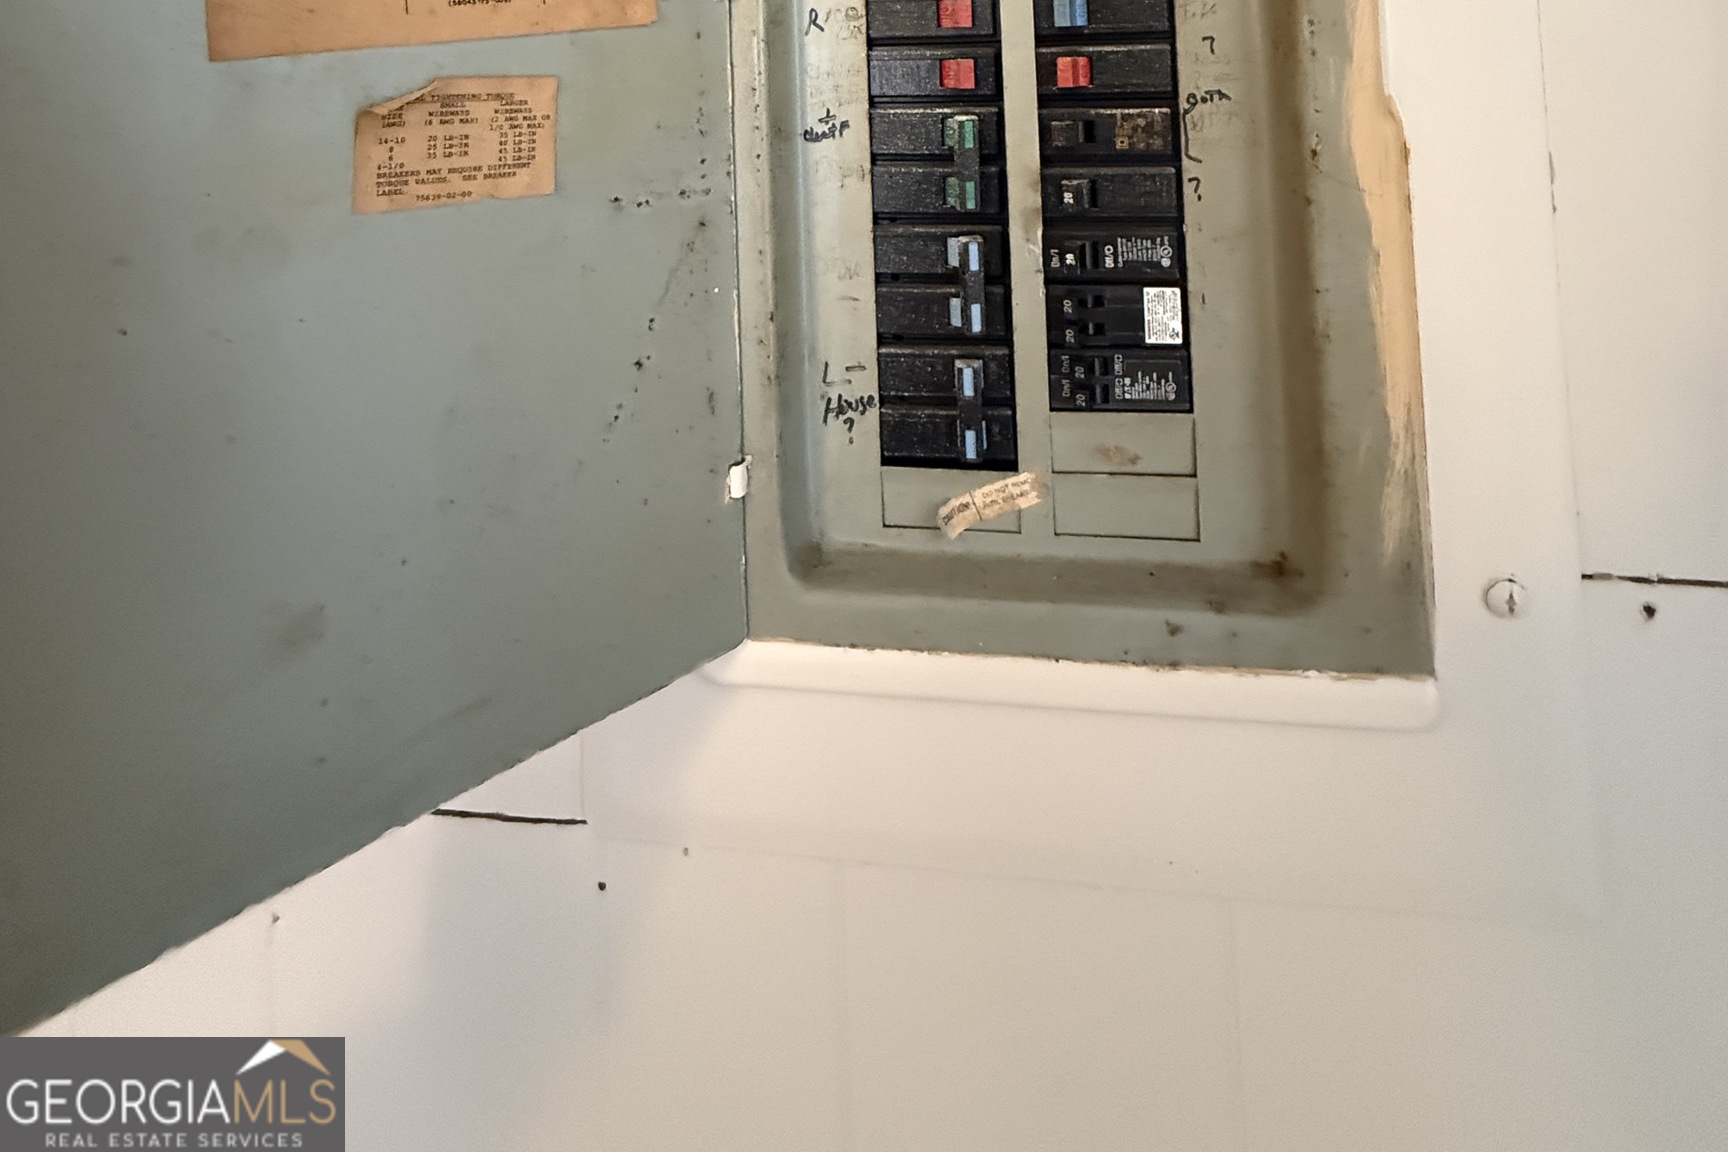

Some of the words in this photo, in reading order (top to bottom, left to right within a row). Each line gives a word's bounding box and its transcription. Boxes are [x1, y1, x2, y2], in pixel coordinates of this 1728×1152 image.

[377, 170, 421, 179] BREAKERS
[488, 162, 531, 171] DIFFERENT
[1063, 191, 1074, 204] 20
[1063, 299, 1073, 314] 20
[1065, 329, 1075, 344] 20
[1075, 366, 1084, 378] 20
[1076, 394, 1085, 407] 20
[823, 393, 877, 426] House
[843, 417, 855, 445] ?
